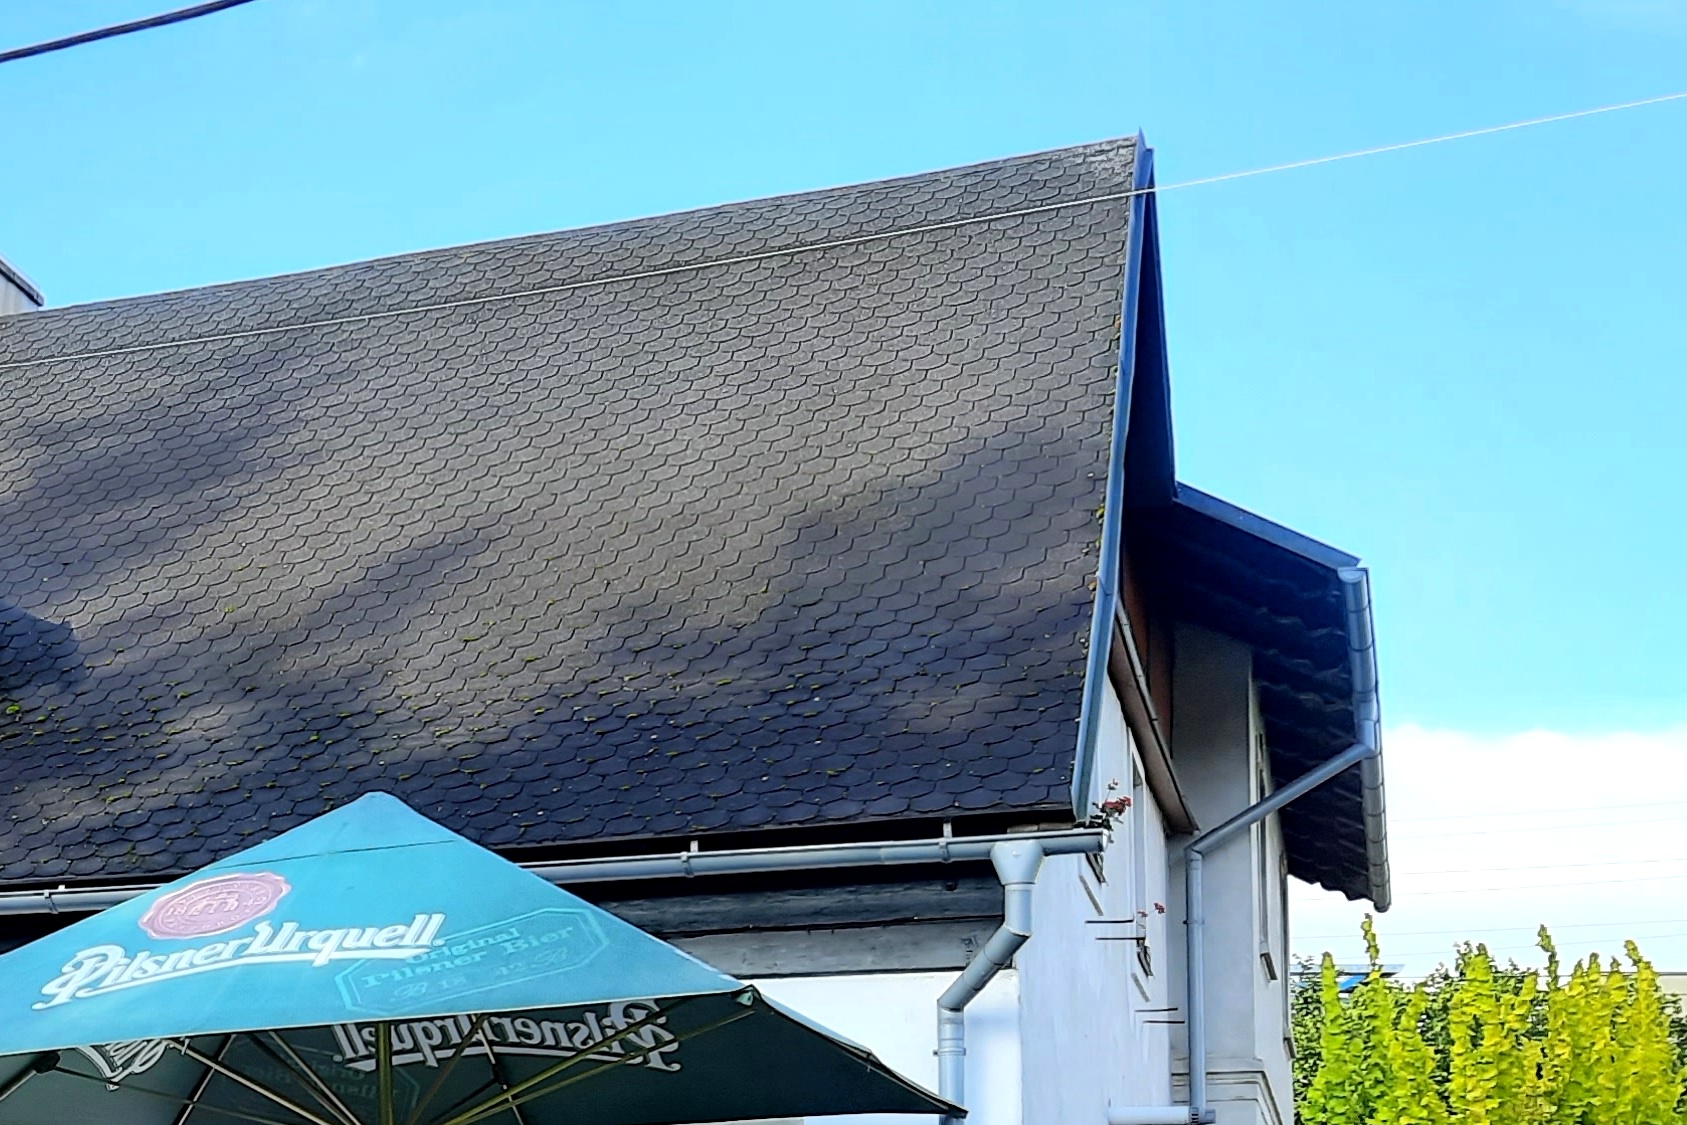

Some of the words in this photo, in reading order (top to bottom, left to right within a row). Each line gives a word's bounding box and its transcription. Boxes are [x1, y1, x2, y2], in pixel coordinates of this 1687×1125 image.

[31, 934, 257, 1011] Pilsner
[242, 912, 445, 967] Urquell
[362, 951, 487, 988] Pilsner
[502, 926, 574, 956] Bier
